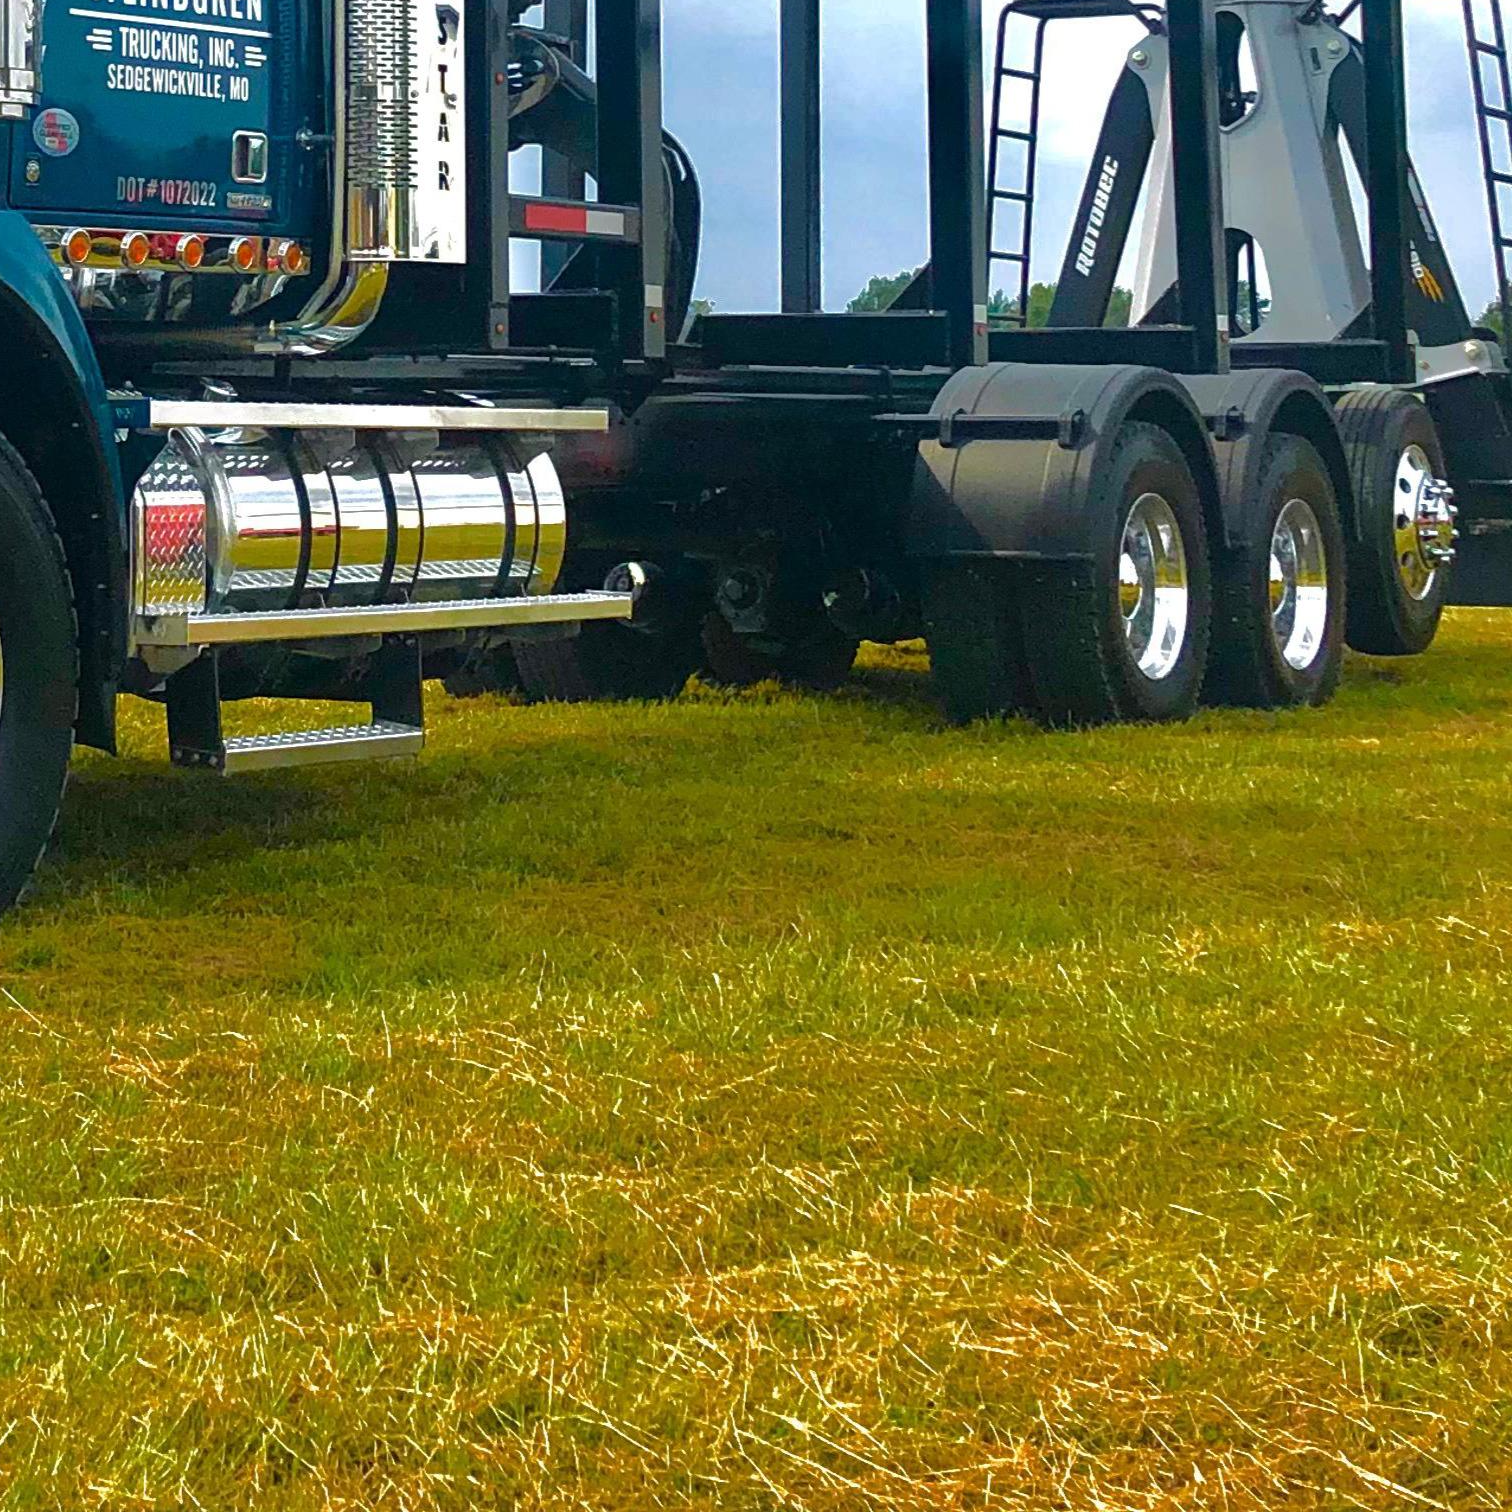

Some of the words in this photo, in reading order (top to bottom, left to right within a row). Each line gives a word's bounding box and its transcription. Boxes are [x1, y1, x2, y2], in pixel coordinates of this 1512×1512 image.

[118, 26, 204, 70] TRUCKING,
[208, 36, 240, 70] INC.
[106, 63, 226, 103] SEDGEWICKVILLE,
[229, 75, 250, 102] MO
[437, 15, 451, 191] STAR
